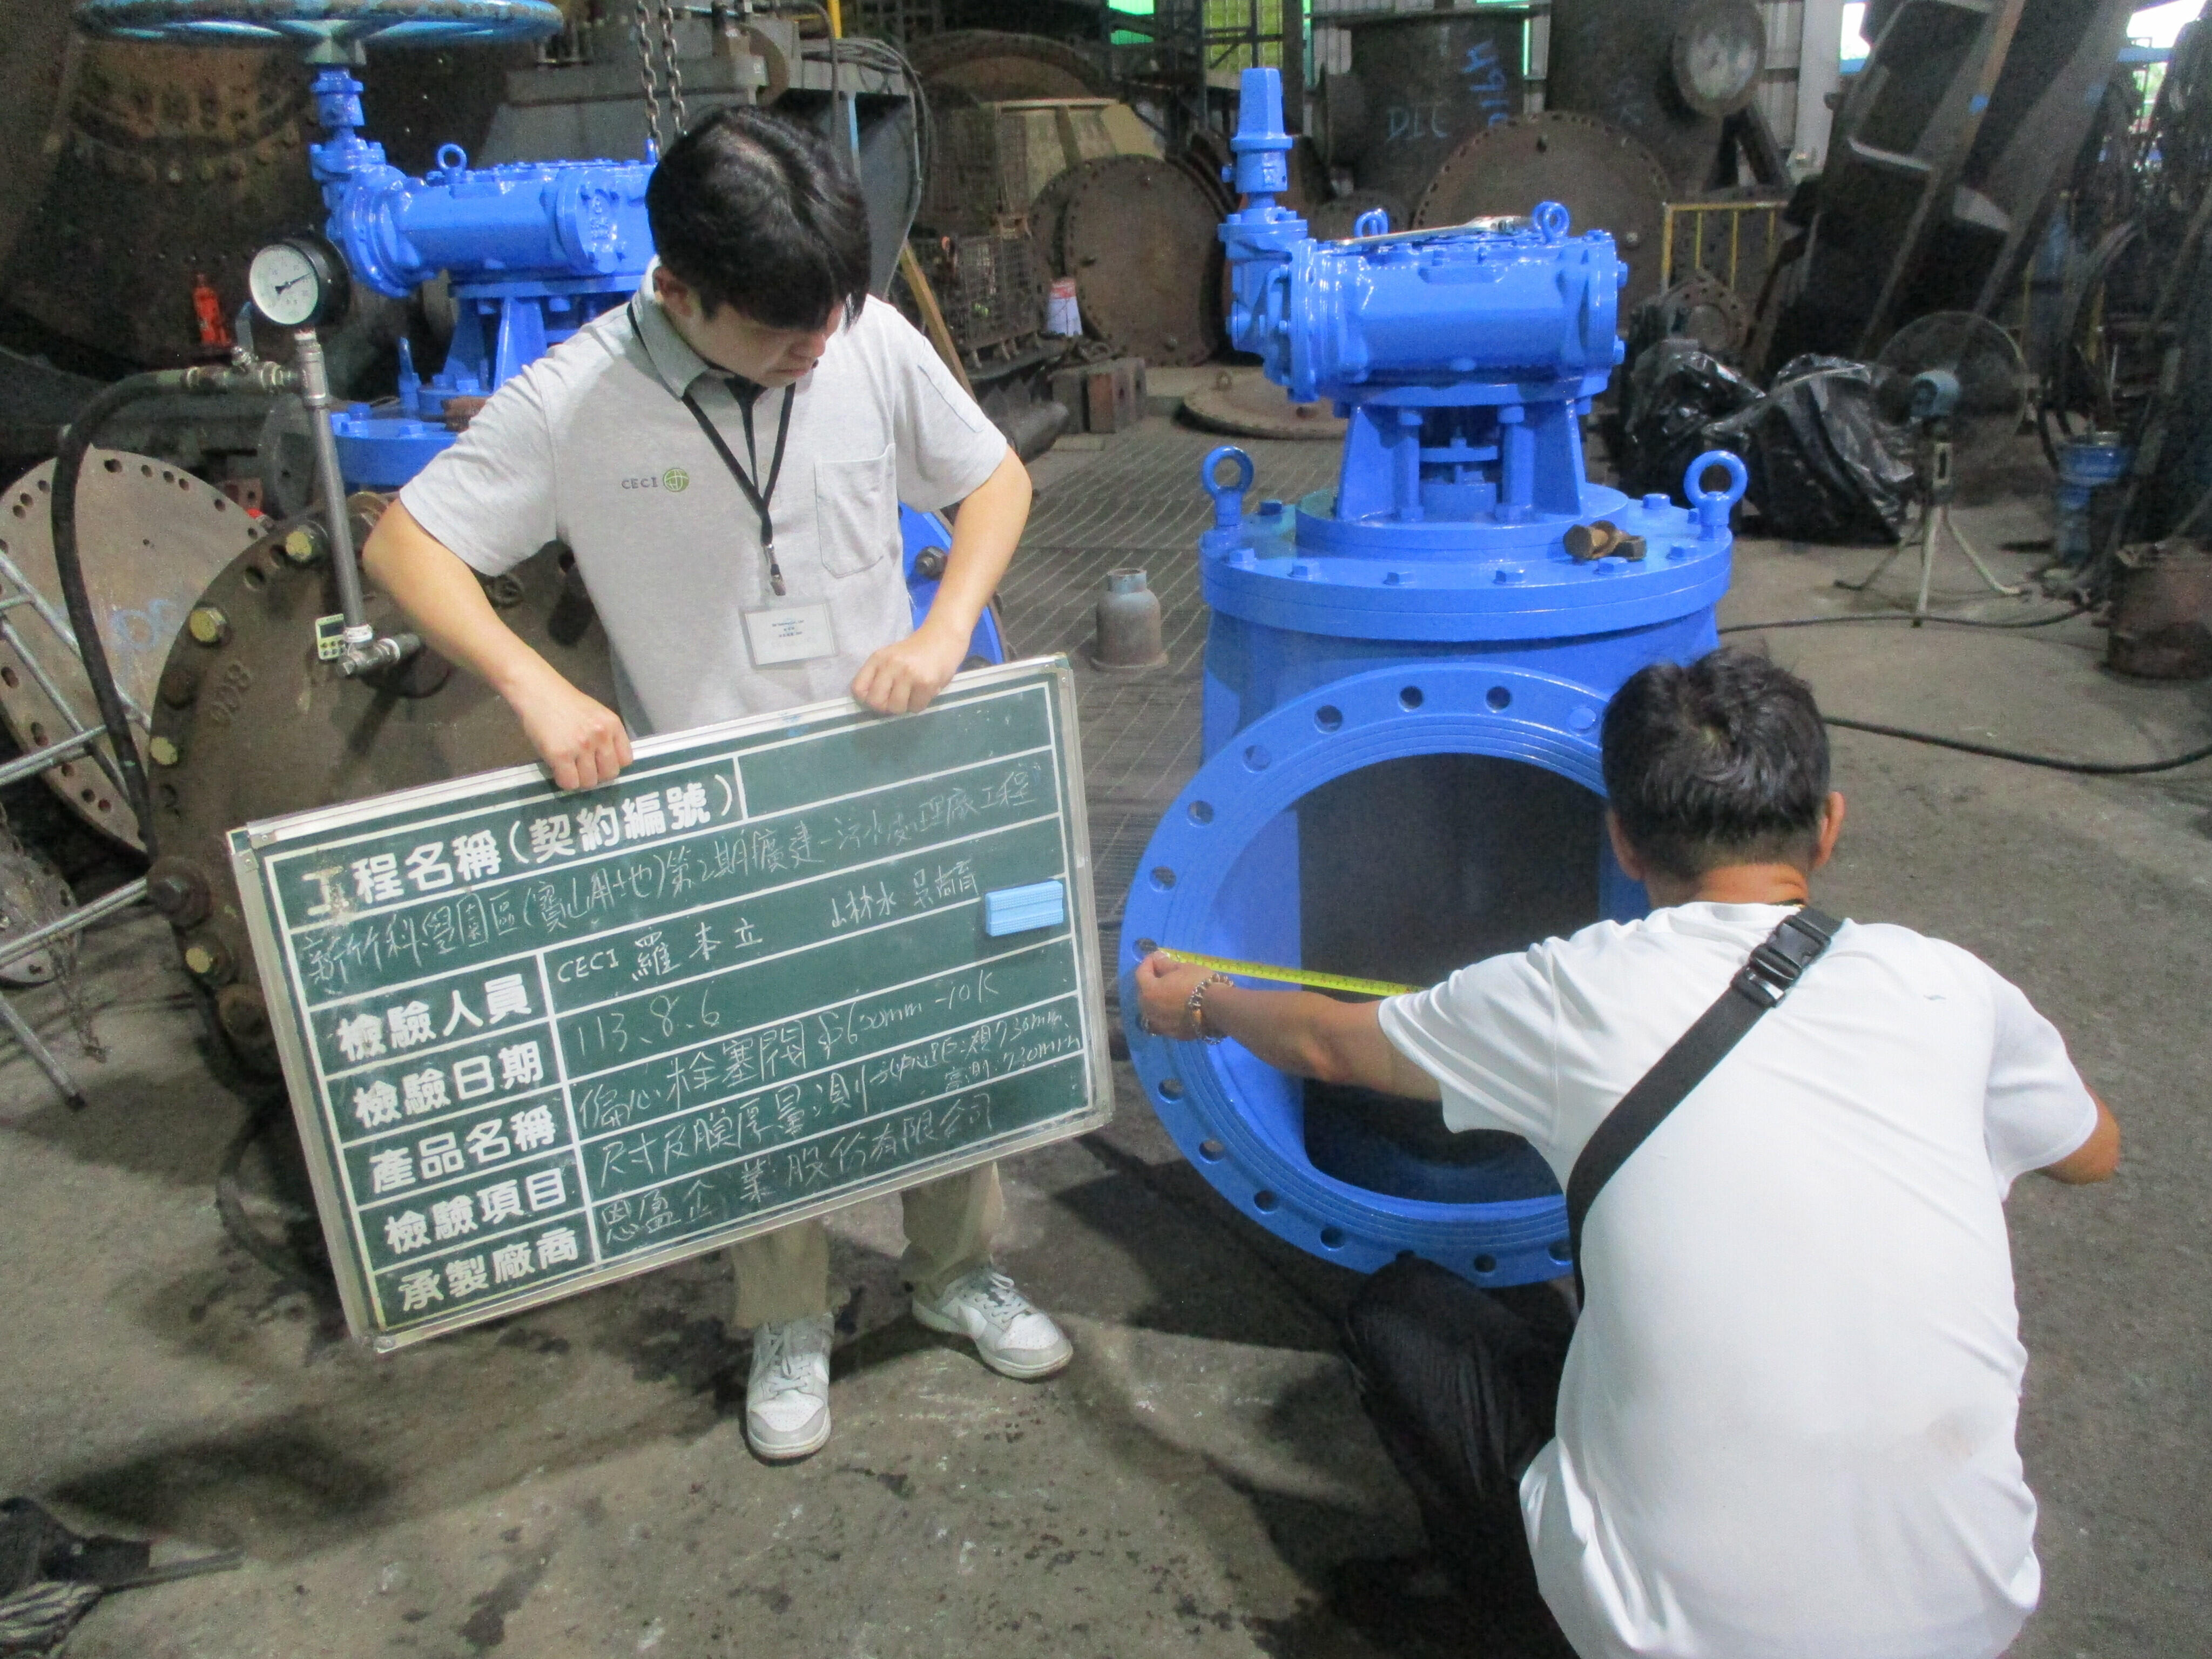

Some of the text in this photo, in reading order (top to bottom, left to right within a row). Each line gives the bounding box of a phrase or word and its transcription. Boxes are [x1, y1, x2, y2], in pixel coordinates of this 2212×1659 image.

[621, 476, 659, 489] CECI
[556, 948, 619, 983] CECI
[336, 973, 533, 1062] 檢驗人員
[353, 1040, 544, 1128] 檢驗日期
[369, 1104, 557, 1194] 產品名稱
[385, 1166, 567, 1255] 檢驗項目
[399, 1226, 578, 1312] 承製廠商
